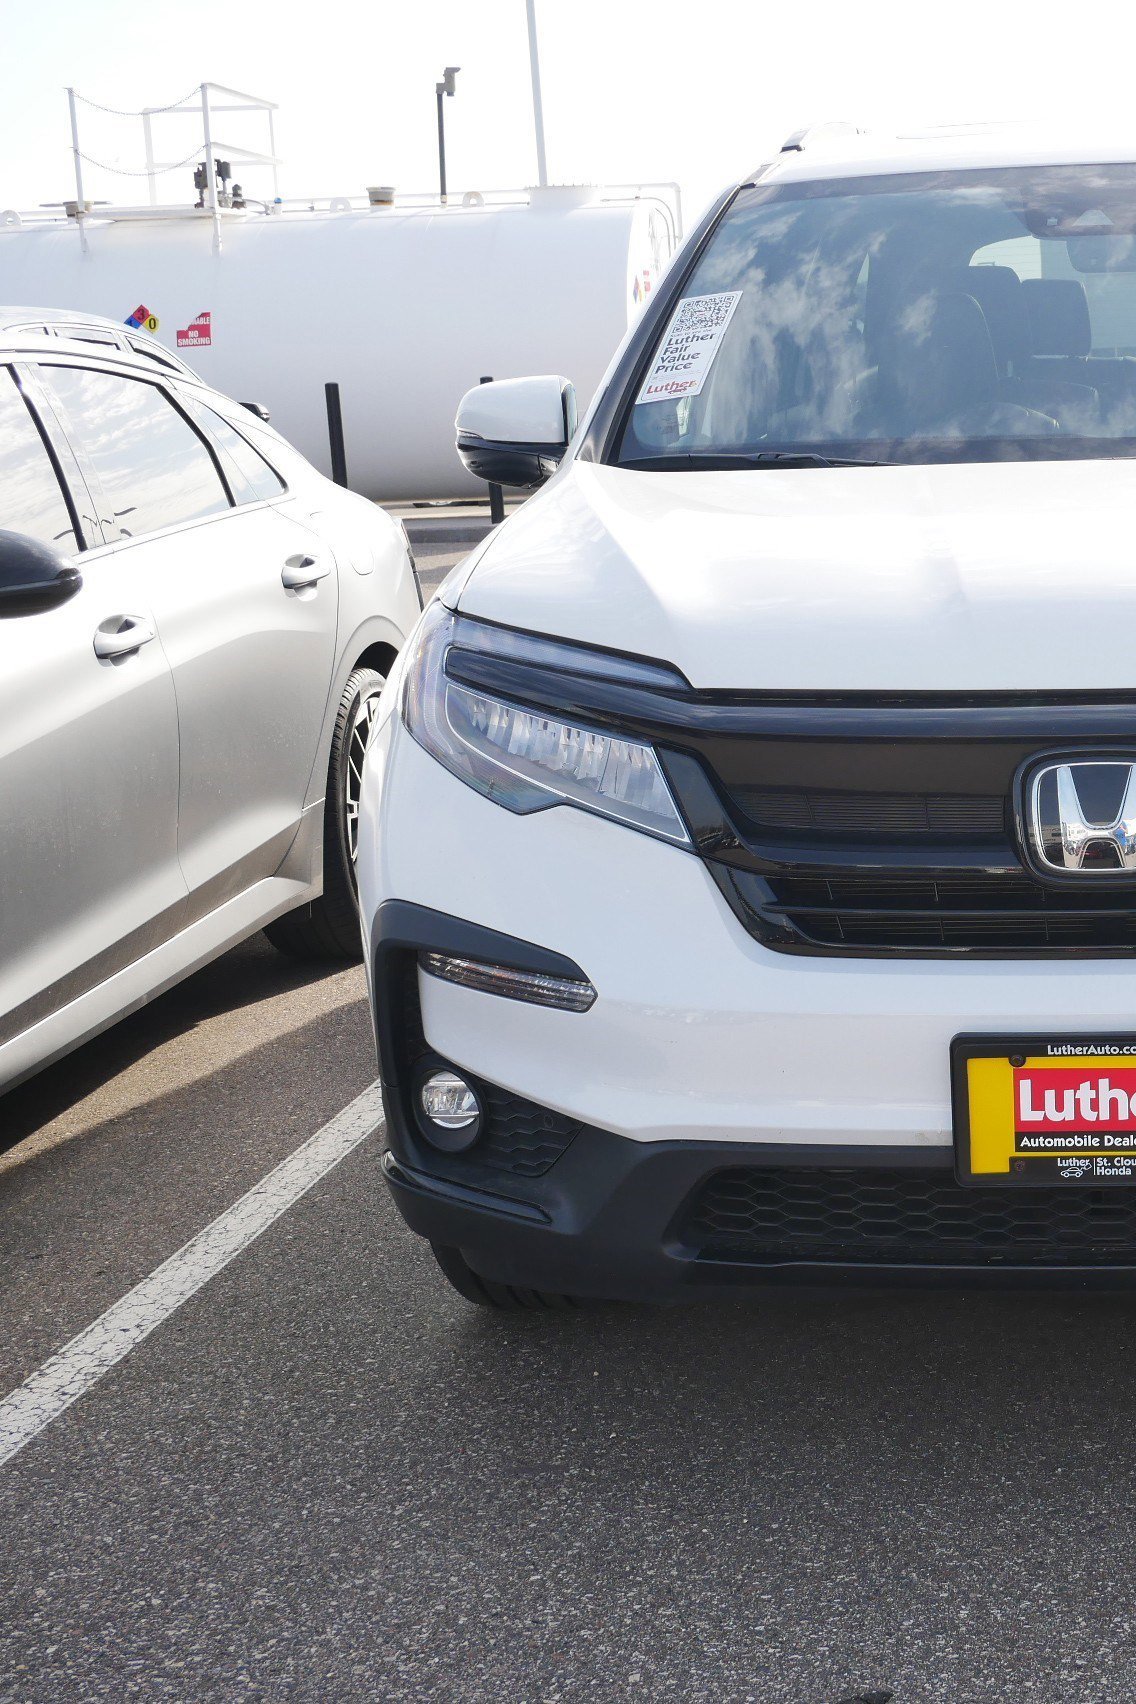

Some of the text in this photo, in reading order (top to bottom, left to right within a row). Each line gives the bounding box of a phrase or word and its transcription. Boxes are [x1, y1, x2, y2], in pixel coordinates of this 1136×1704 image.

[138, 308, 146, 321] 3
[149, 318, 157, 330] 0
[178, 337, 210, 346] SMOKING
[667, 333, 716, 346] Luther
[663, 344, 690, 355] Fair
[660, 352, 701, 364] Value
[655, 362, 693, 374] Price
[646, 380, 696, 394] Luther
[1020, 1135, 1100, 1148] Automobile
[1057, 1157, 1090, 1167] Luther
[1096, 1157, 1111, 1166] St.
[1096, 1166, 1132, 1176] Honda
